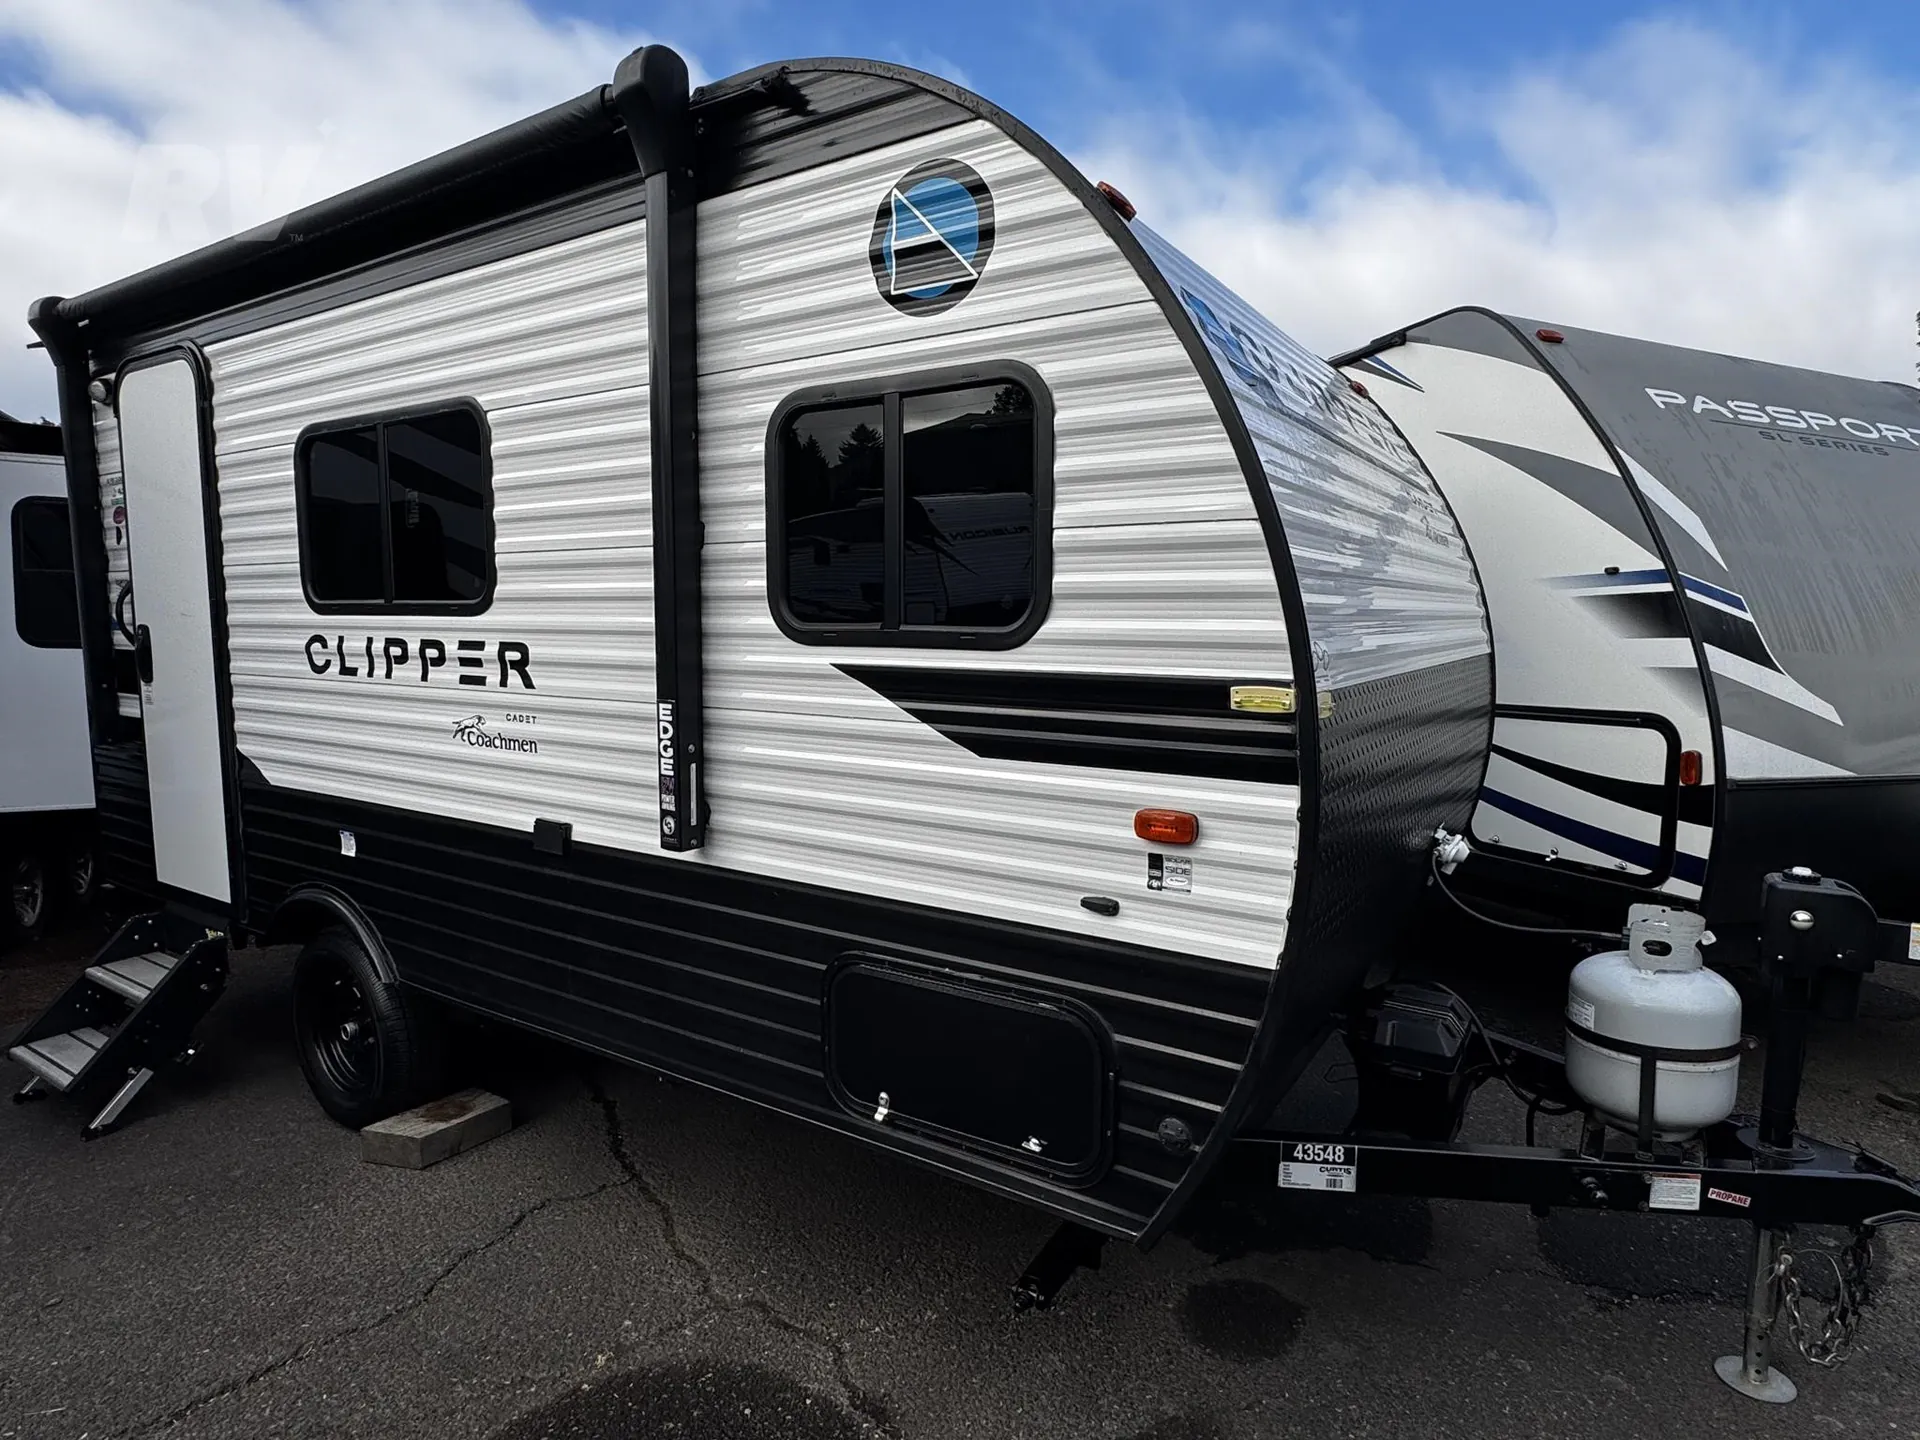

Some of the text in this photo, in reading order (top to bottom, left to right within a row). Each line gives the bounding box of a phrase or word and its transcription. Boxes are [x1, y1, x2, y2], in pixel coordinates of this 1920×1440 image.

[1644, 387, 1920, 447] PASSPOR
[1758, 429, 1890, 457] SL SERIES
[304, 633, 537, 690] CLIPPER
[505, 712, 538, 725] CADET
[466, 730, 538, 754] Coachmen
[658, 702, 674, 776] EDGE
[1164, 865, 1191, 875] SIDE
[1293, 1143, 1345, 1163] 43548
[1319, 1166, 1352, 1175] CURTIS
[1709, 1189, 1749, 1206] PROPANE
